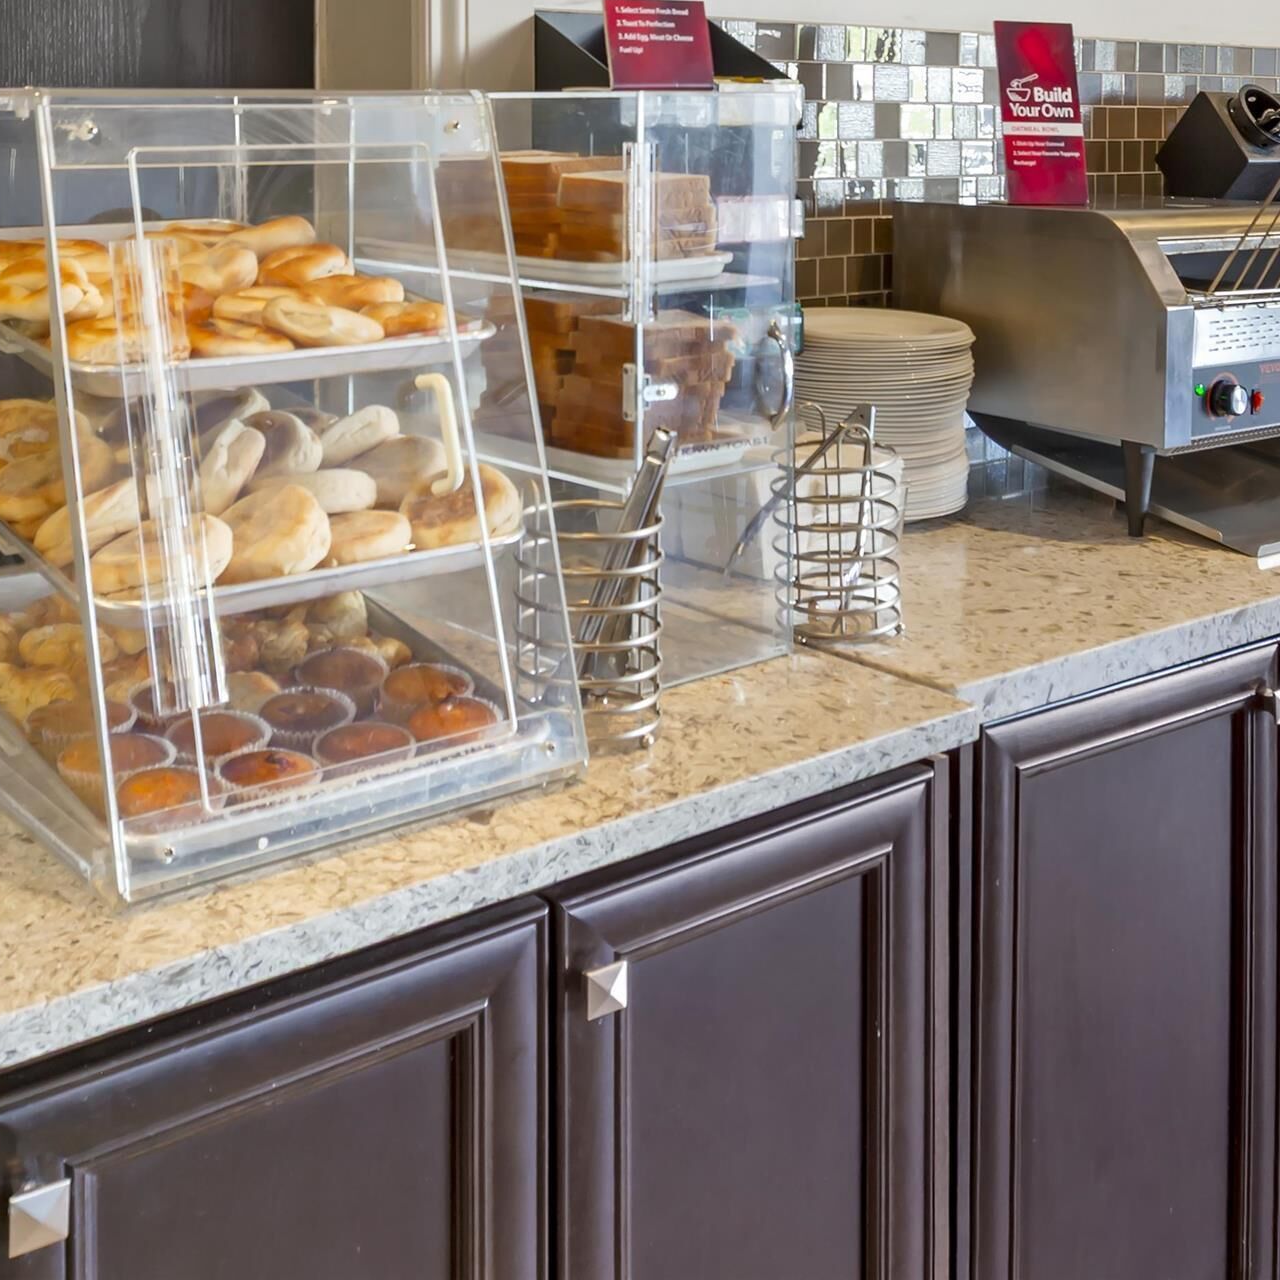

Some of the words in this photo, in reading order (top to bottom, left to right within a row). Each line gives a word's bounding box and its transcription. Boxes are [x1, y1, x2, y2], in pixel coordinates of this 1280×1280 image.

[1033, 87, 1073, 103] Build
[1009, 103, 1040, 117] Your
[1041, 104, 1074, 118] Own
